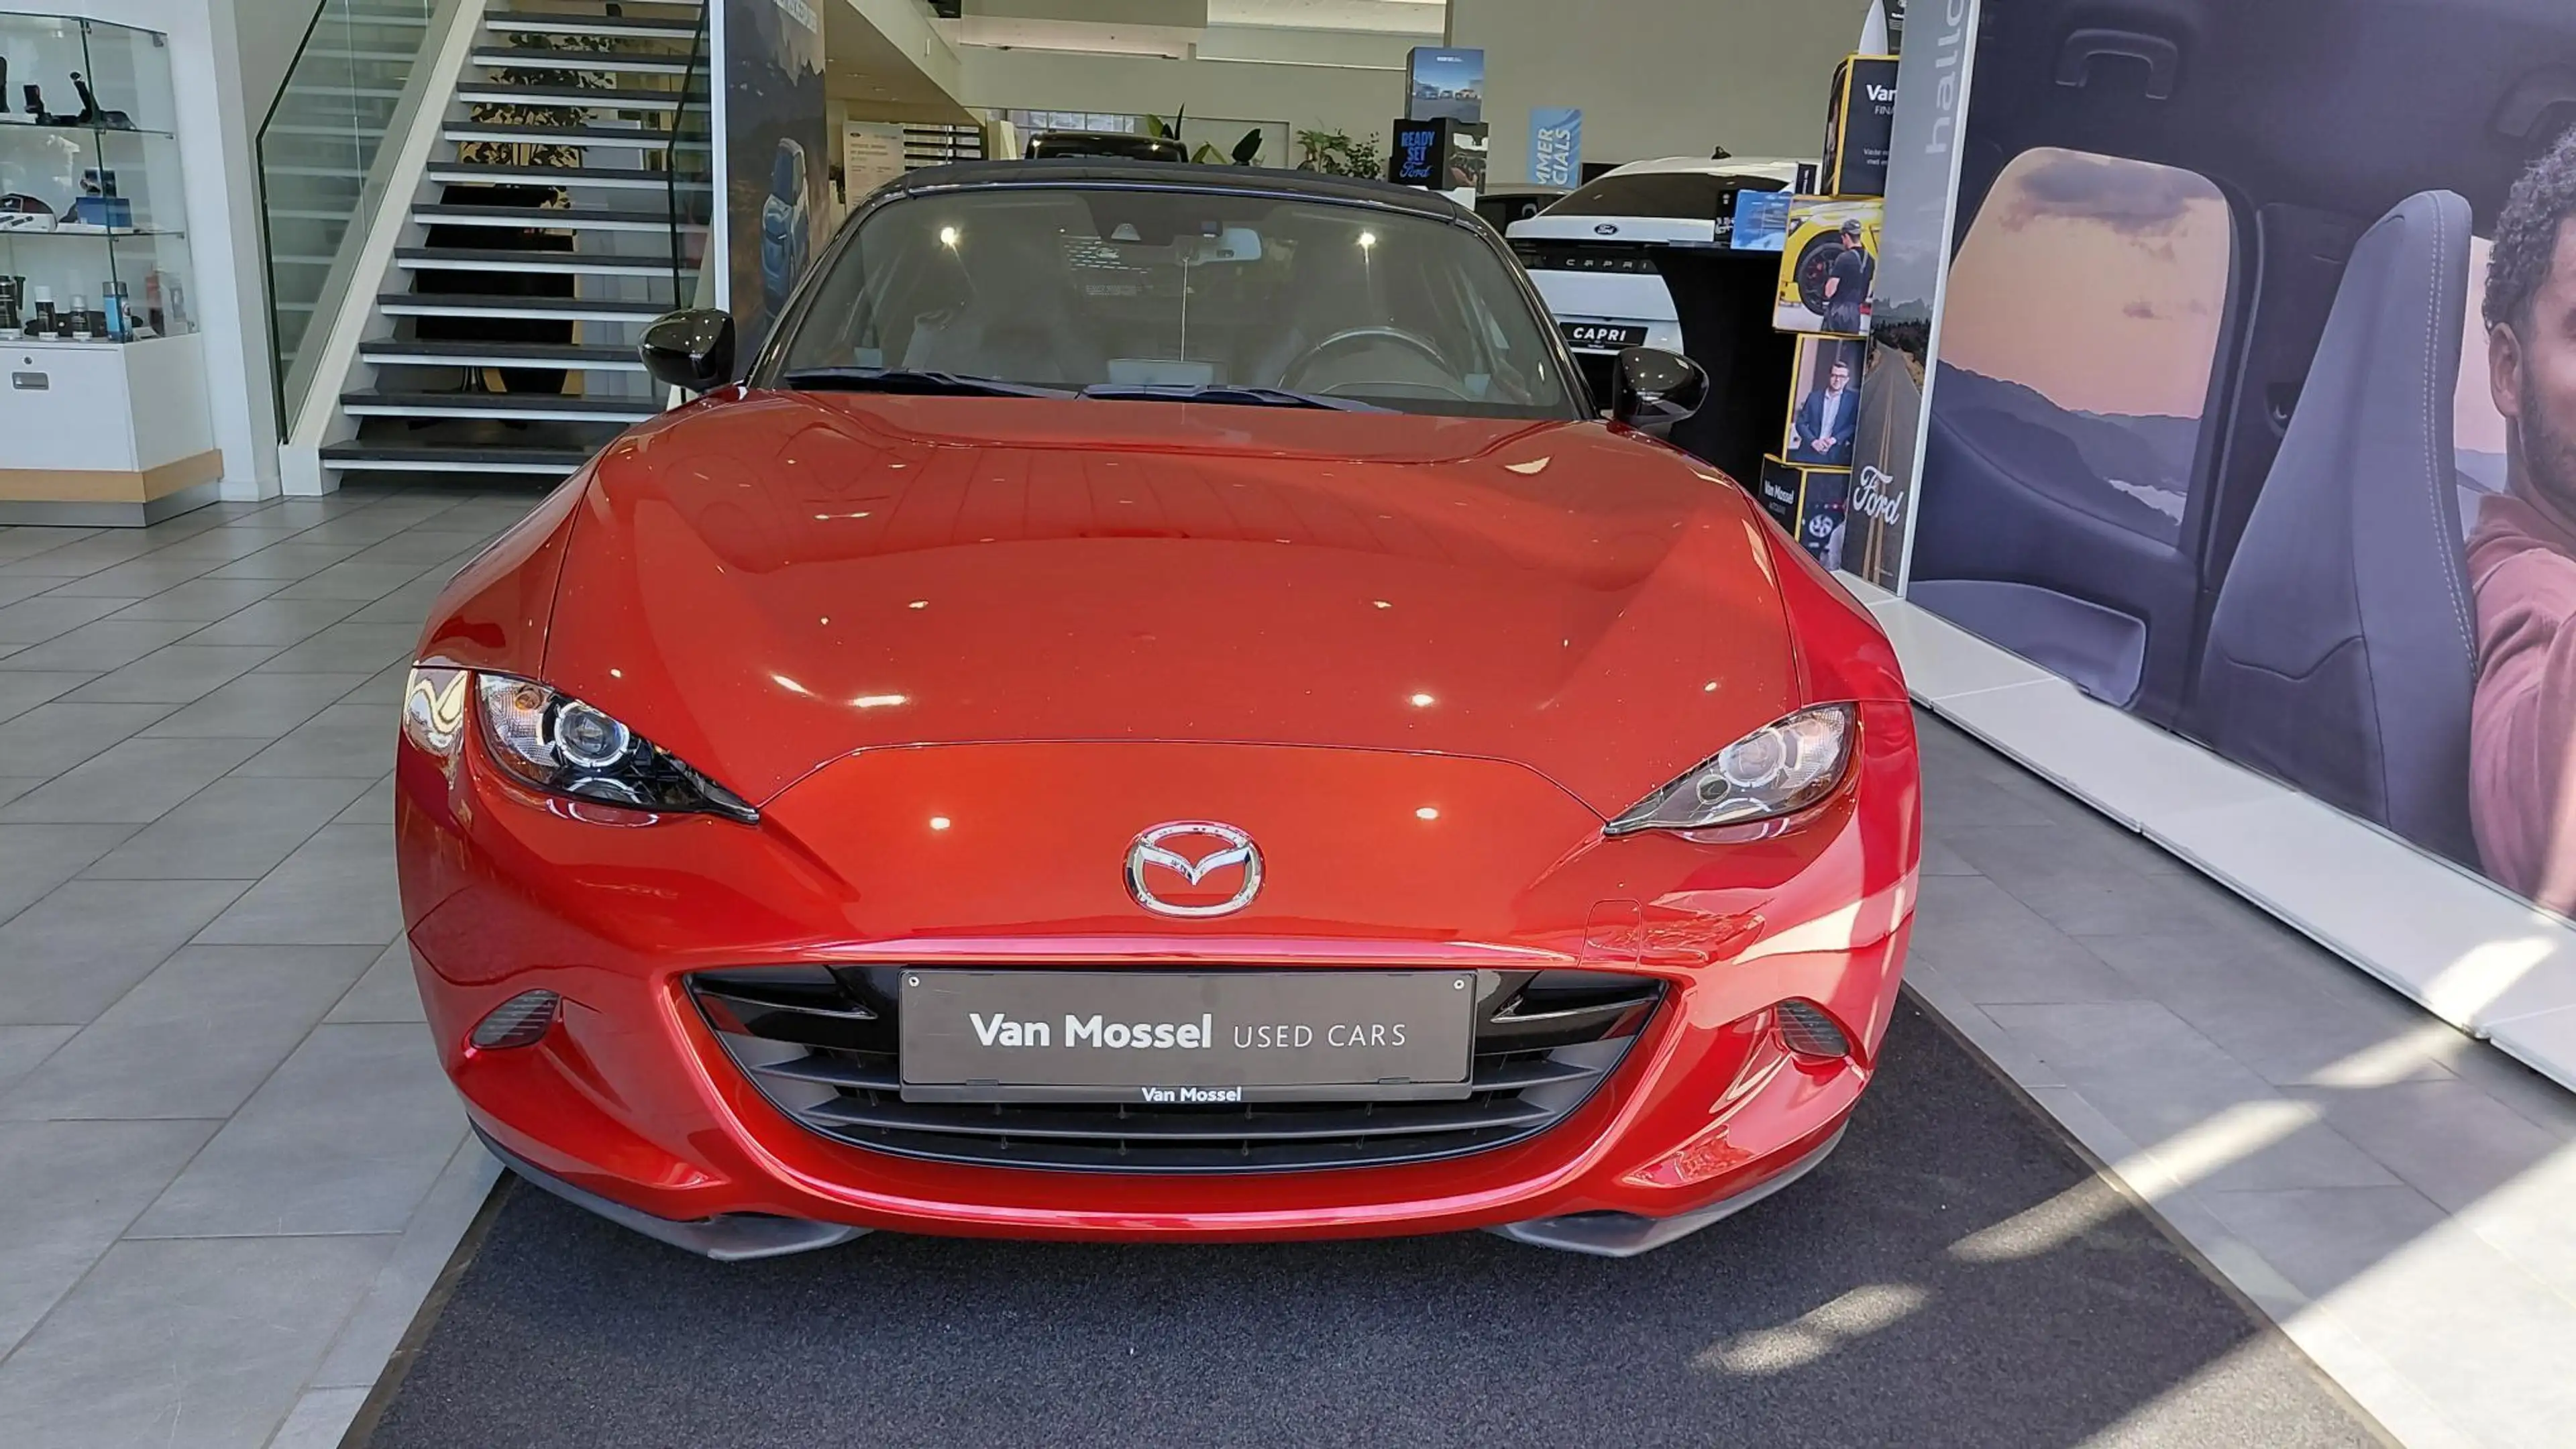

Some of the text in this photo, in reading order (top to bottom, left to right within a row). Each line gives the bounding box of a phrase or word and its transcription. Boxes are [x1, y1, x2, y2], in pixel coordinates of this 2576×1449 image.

[1401, 131, 1435, 146] READY
[1407, 146, 1426, 160] SET
[1552, 128, 1570, 185] CIALS
[1399, 161, 1433, 178] Ford
[1573, 327, 1626, 341] CAPRI
[1854, 466, 1904, 525] Ford
[969, 1013, 1406, 1049] Van Mossel USED CARS
[1141, 1087, 1242, 1102] Van Mossel
